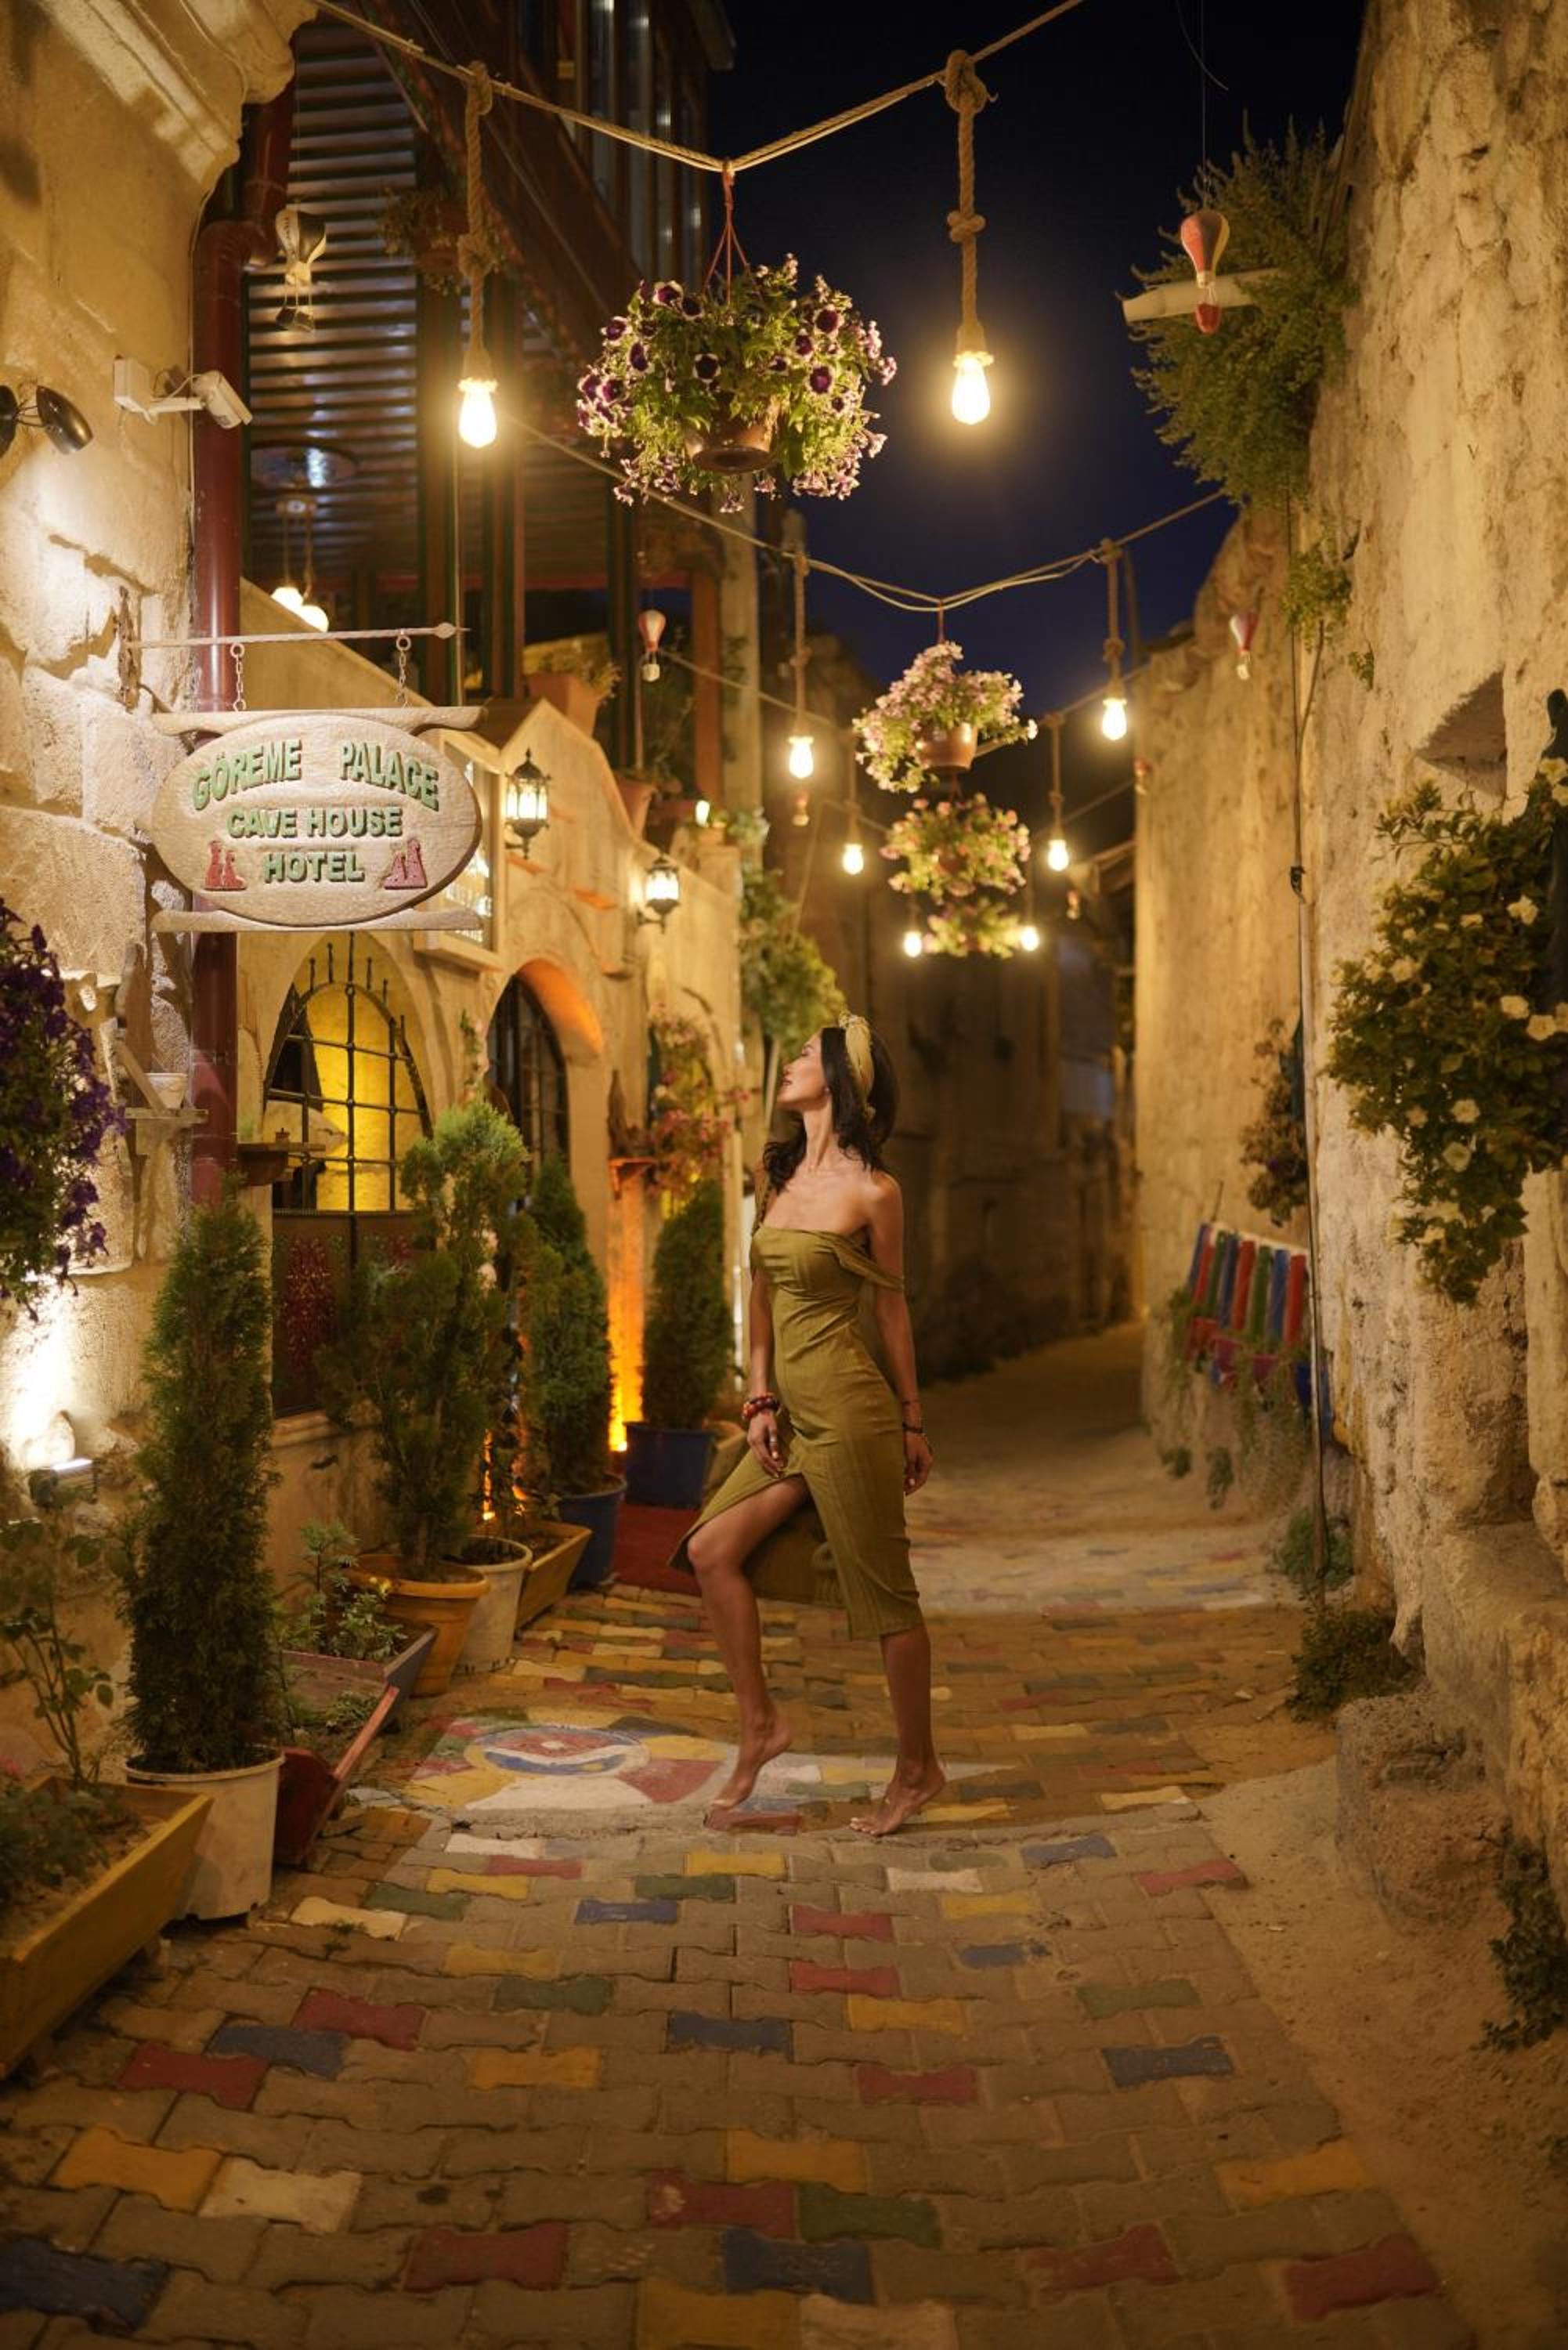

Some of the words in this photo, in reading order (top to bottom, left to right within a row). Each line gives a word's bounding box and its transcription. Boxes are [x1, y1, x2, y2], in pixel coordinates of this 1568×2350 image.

[193, 738, 302, 811] GÖREME
[340, 740, 439, 812] PALACE
[227, 809, 298, 838] CAVE
[306, 807, 403, 837] HOUSE
[263, 851, 364, 884] HOTEL
